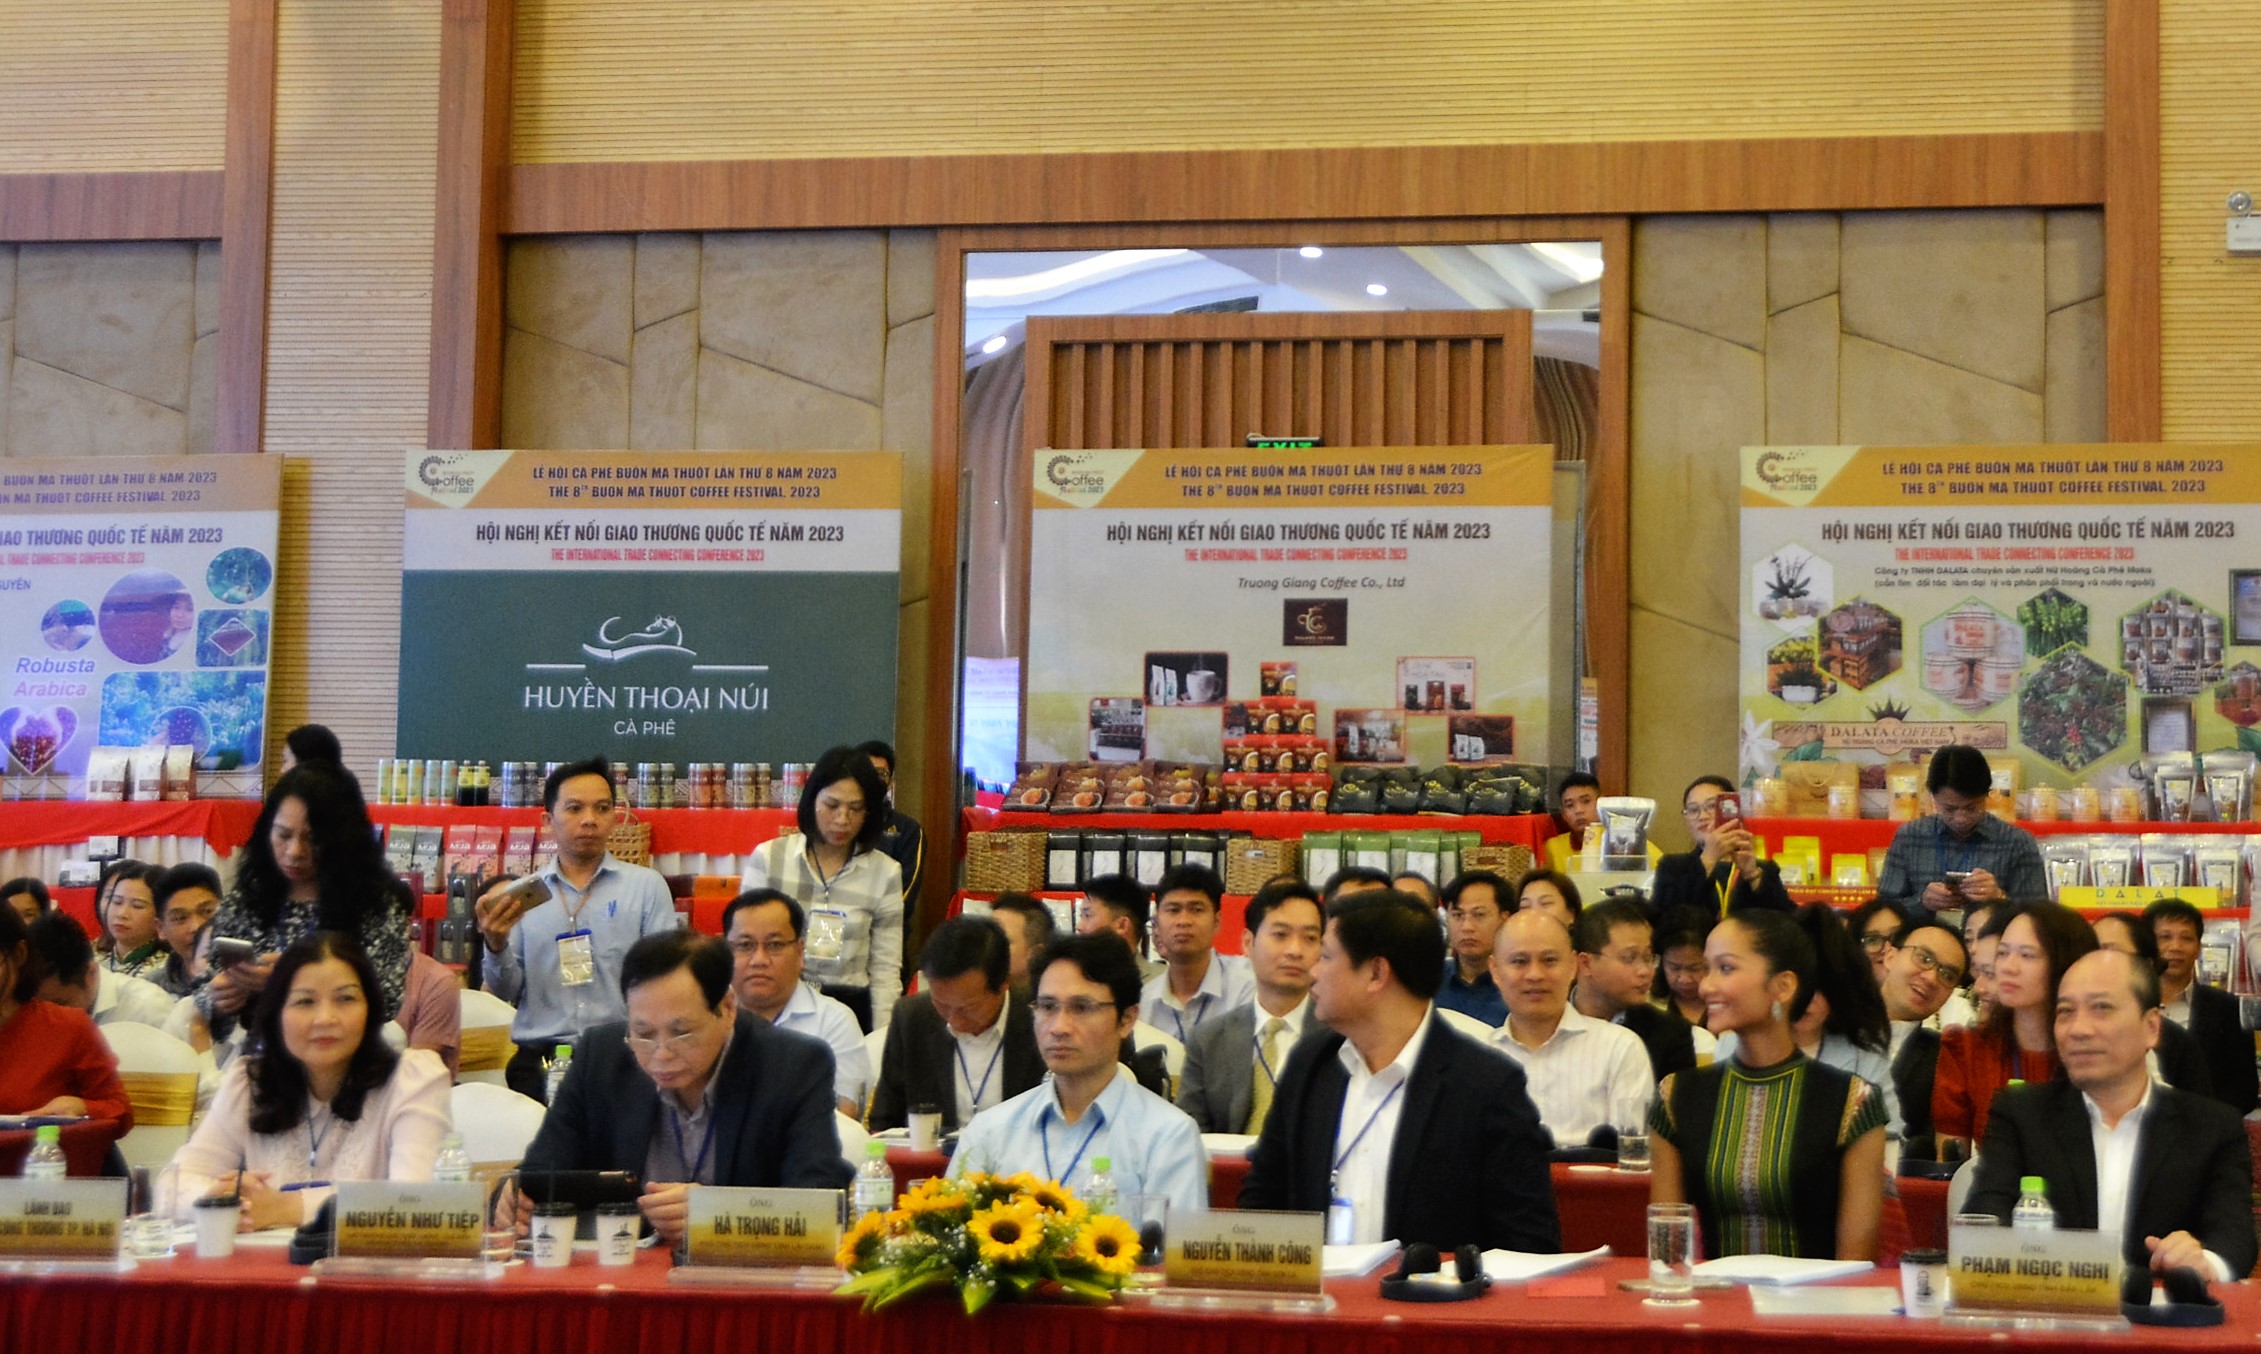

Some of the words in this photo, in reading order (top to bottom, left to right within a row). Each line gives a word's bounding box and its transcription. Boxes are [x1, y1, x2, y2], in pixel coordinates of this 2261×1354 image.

[650, 467, 669, 479] MA
[806, 467, 836, 479] 2023
[1287, 466, 1306, 477] MA
[1450, 463, 1482, 475] 2023
[2014, 462, 2034, 474] MA
[2188, 460, 2223, 473] 2023
[549, 486, 568, 498] THE
[626, 486, 645, 498] MA
[689, 486, 729, 498] COFFEE
[790, 486, 820, 498] 2023
[1182, 485, 1202, 497] THE
[1262, 484, 1282, 496] MA
[1328, 484, 1370, 496] COFFEE
[1432, 483, 1464, 495] 2023
[1900, 481, 1923, 494] THE
[1988, 480, 2008, 493] MA
[2058, 480, 2103, 493] COFFEE
[2171, 479, 2205, 492] 2023
[13, 492, 30, 505] MA
[74, 490, 113, 504] COFFEE
[170, 489, 200, 503] 2023
[27, 528, 82, 547] THƯƠNG
[86, 522, 125, 547] QUỐC
[130, 522, 146, 545] TẾ
[150, 525, 184, 544] NĂM
[188, 528, 222, 544] 2023
[476, 522, 500, 544] HỘI
[504, 526, 540, 545] NGHỊ
[543, 518, 568, 541] KẾT
[574, 518, 600, 541] NỐI
[604, 526, 638, 541] GIAO
[643, 524, 700, 541] THƯƠNG
[704, 518, 744, 542] QUỐC
[749, 518, 764, 541] TẾ
[768, 522, 804, 541] NĂM
[808, 526, 844, 541] 2023
[1106, 522, 1132, 544] HỘI
[1136, 525, 1172, 545] NGHỊ
[1176, 518, 1203, 541] KẾT
[1208, 518, 1235, 540] NỐI
[1239, 525, 1275, 540] GIAO
[1280, 524, 1340, 540] THƯƠNG
[1344, 518, 1385, 541] QUỐC
[1391, 518, 1407, 540] TẾ
[1412, 521, 1448, 539] NĂM
[1453, 525, 1490, 539] 2023
[1821, 521, 1848, 543] HỘI
[1853, 524, 1892, 544] NGHỊ
[1896, 517, 1925, 540] KẾT
[1930, 517, 1960, 539] NỐI
[1964, 524, 2002, 539] GIAO
[2008, 522, 2072, 539] THƯƠNG
[2077, 516, 2121, 540] QUỐC
[2128, 516, 2144, 539] TẾ
[2150, 519, 2189, 538] NĂM
[2194, 523, 2234, 538] 2023
[1238, 577, 1279, 590] Truong
[1282, 577, 1317, 590] Giang
[1319, 576, 1358, 590] Coffee
[1386, 576, 1406, 587] Ltd
[16, 657, 96, 673] Robusta
[14, 680, 88, 697] Arabica
[524, 677, 616, 708] HUYỀN
[624, 686, 709, 713] THOẠI
[719, 683, 768, 709] NÚI
[613, 717, 638, 735] CÀ
[642, 719, 676, 735] PHÊ
[1829, 726, 1888, 737] DALATA
[1892, 726, 1948, 737] COFFEE
[410, 1211, 443, 1229] NHƯ
[736, 1215, 780, 1240] TRỌNG
[1182, 1234, 1232, 1262] NGUYỄN
[1235, 1238, 1275, 1263] THÀNH
[1277, 1240, 1312, 1265] CÔNG
[1961, 1255, 2011, 1277] PHẠM
[2016, 1258, 2063, 1280] NGỌC
